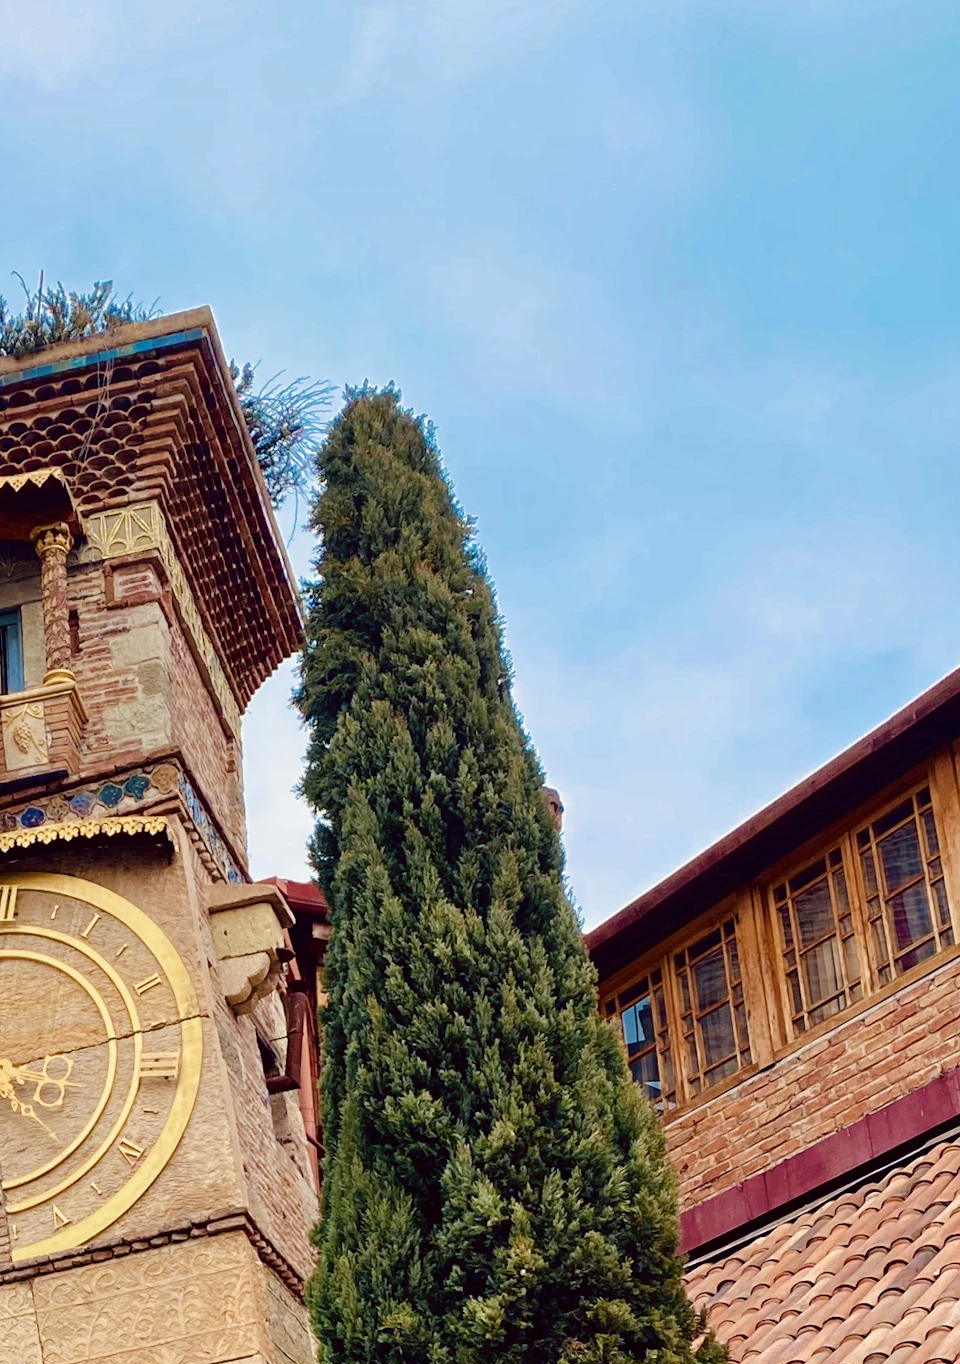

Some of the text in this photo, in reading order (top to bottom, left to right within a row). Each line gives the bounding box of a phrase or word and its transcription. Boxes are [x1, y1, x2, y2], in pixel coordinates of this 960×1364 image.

[81, 913, 102, 939] I
[133, 972, 162, 995] II
[139, 1047, 180, 1080] III
[118, 1136, 146, 1169] IV
[52, 1204, 72, 1230] V
